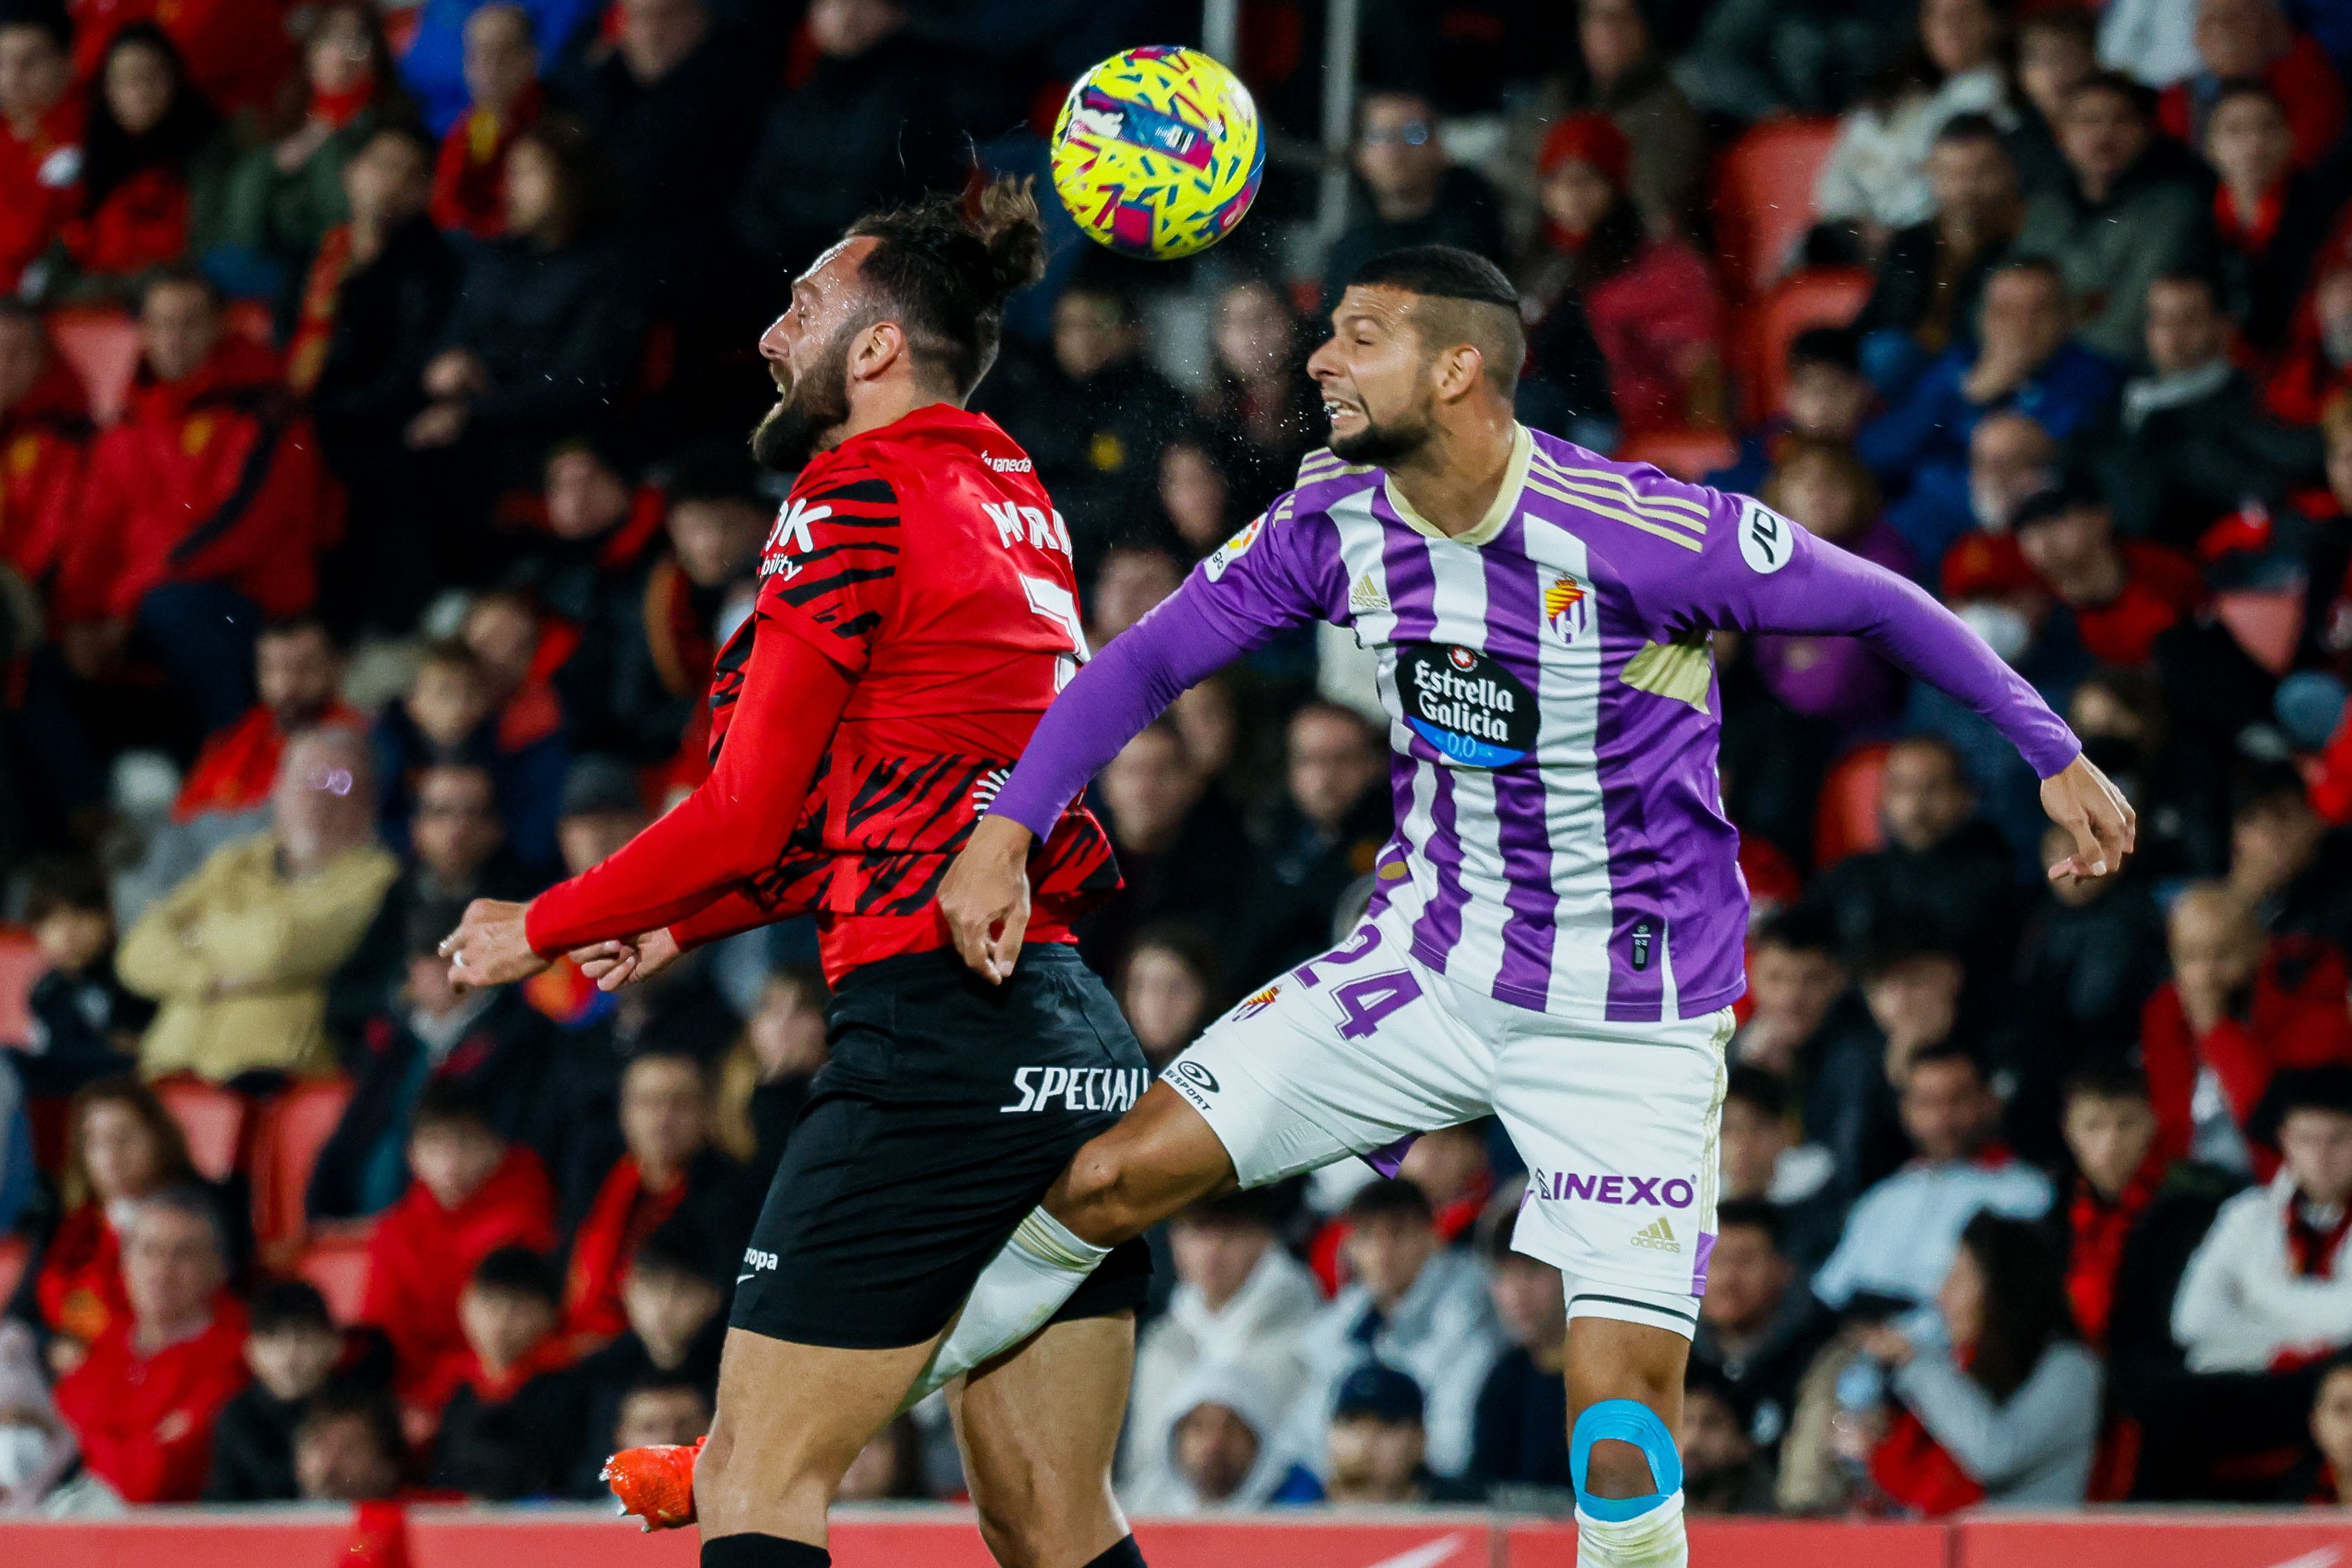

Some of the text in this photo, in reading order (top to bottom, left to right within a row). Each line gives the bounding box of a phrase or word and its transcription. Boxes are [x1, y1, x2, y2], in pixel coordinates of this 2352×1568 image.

[1414, 659, 1516, 713] Estrella
[1419, 690, 1509, 743] Galicia
[1290, 924, 1423, 1041] 24
[1630, 1236, 1681, 1254] adidas
